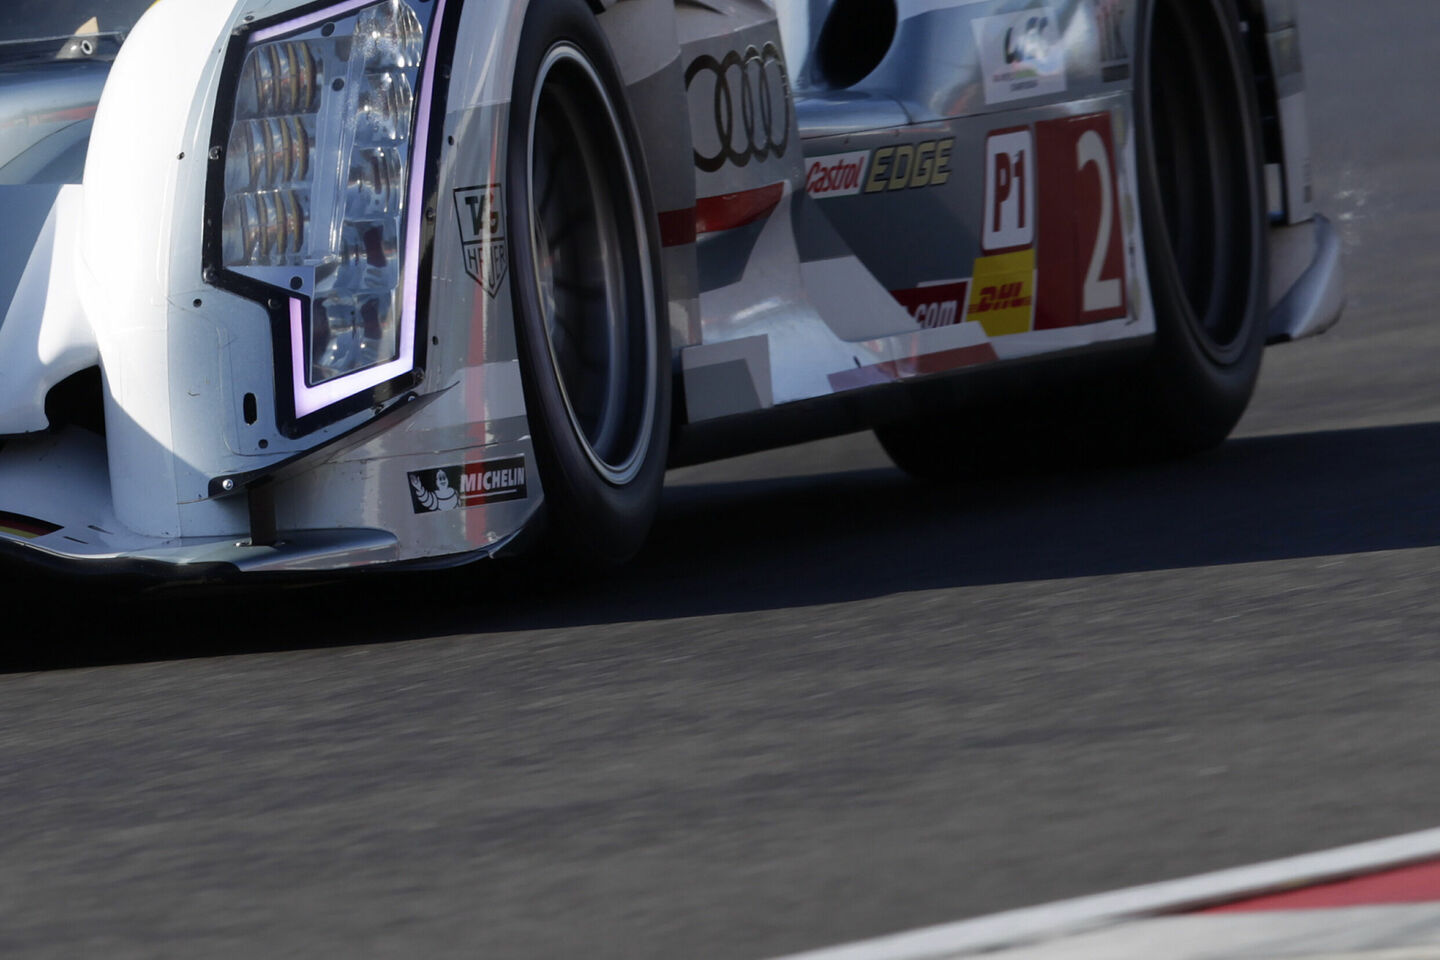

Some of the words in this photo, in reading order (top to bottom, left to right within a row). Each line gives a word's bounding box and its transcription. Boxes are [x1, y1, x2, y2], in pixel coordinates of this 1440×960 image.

[806, 155, 865, 193] Castrol
[863, 137, 956, 193] EDGE
[993, 150, 1026, 233] P1
[1076, 129, 1122, 312] 2
[975, 281, 1028, 313] DHL
[460, 467, 525, 493] MICHELIN
